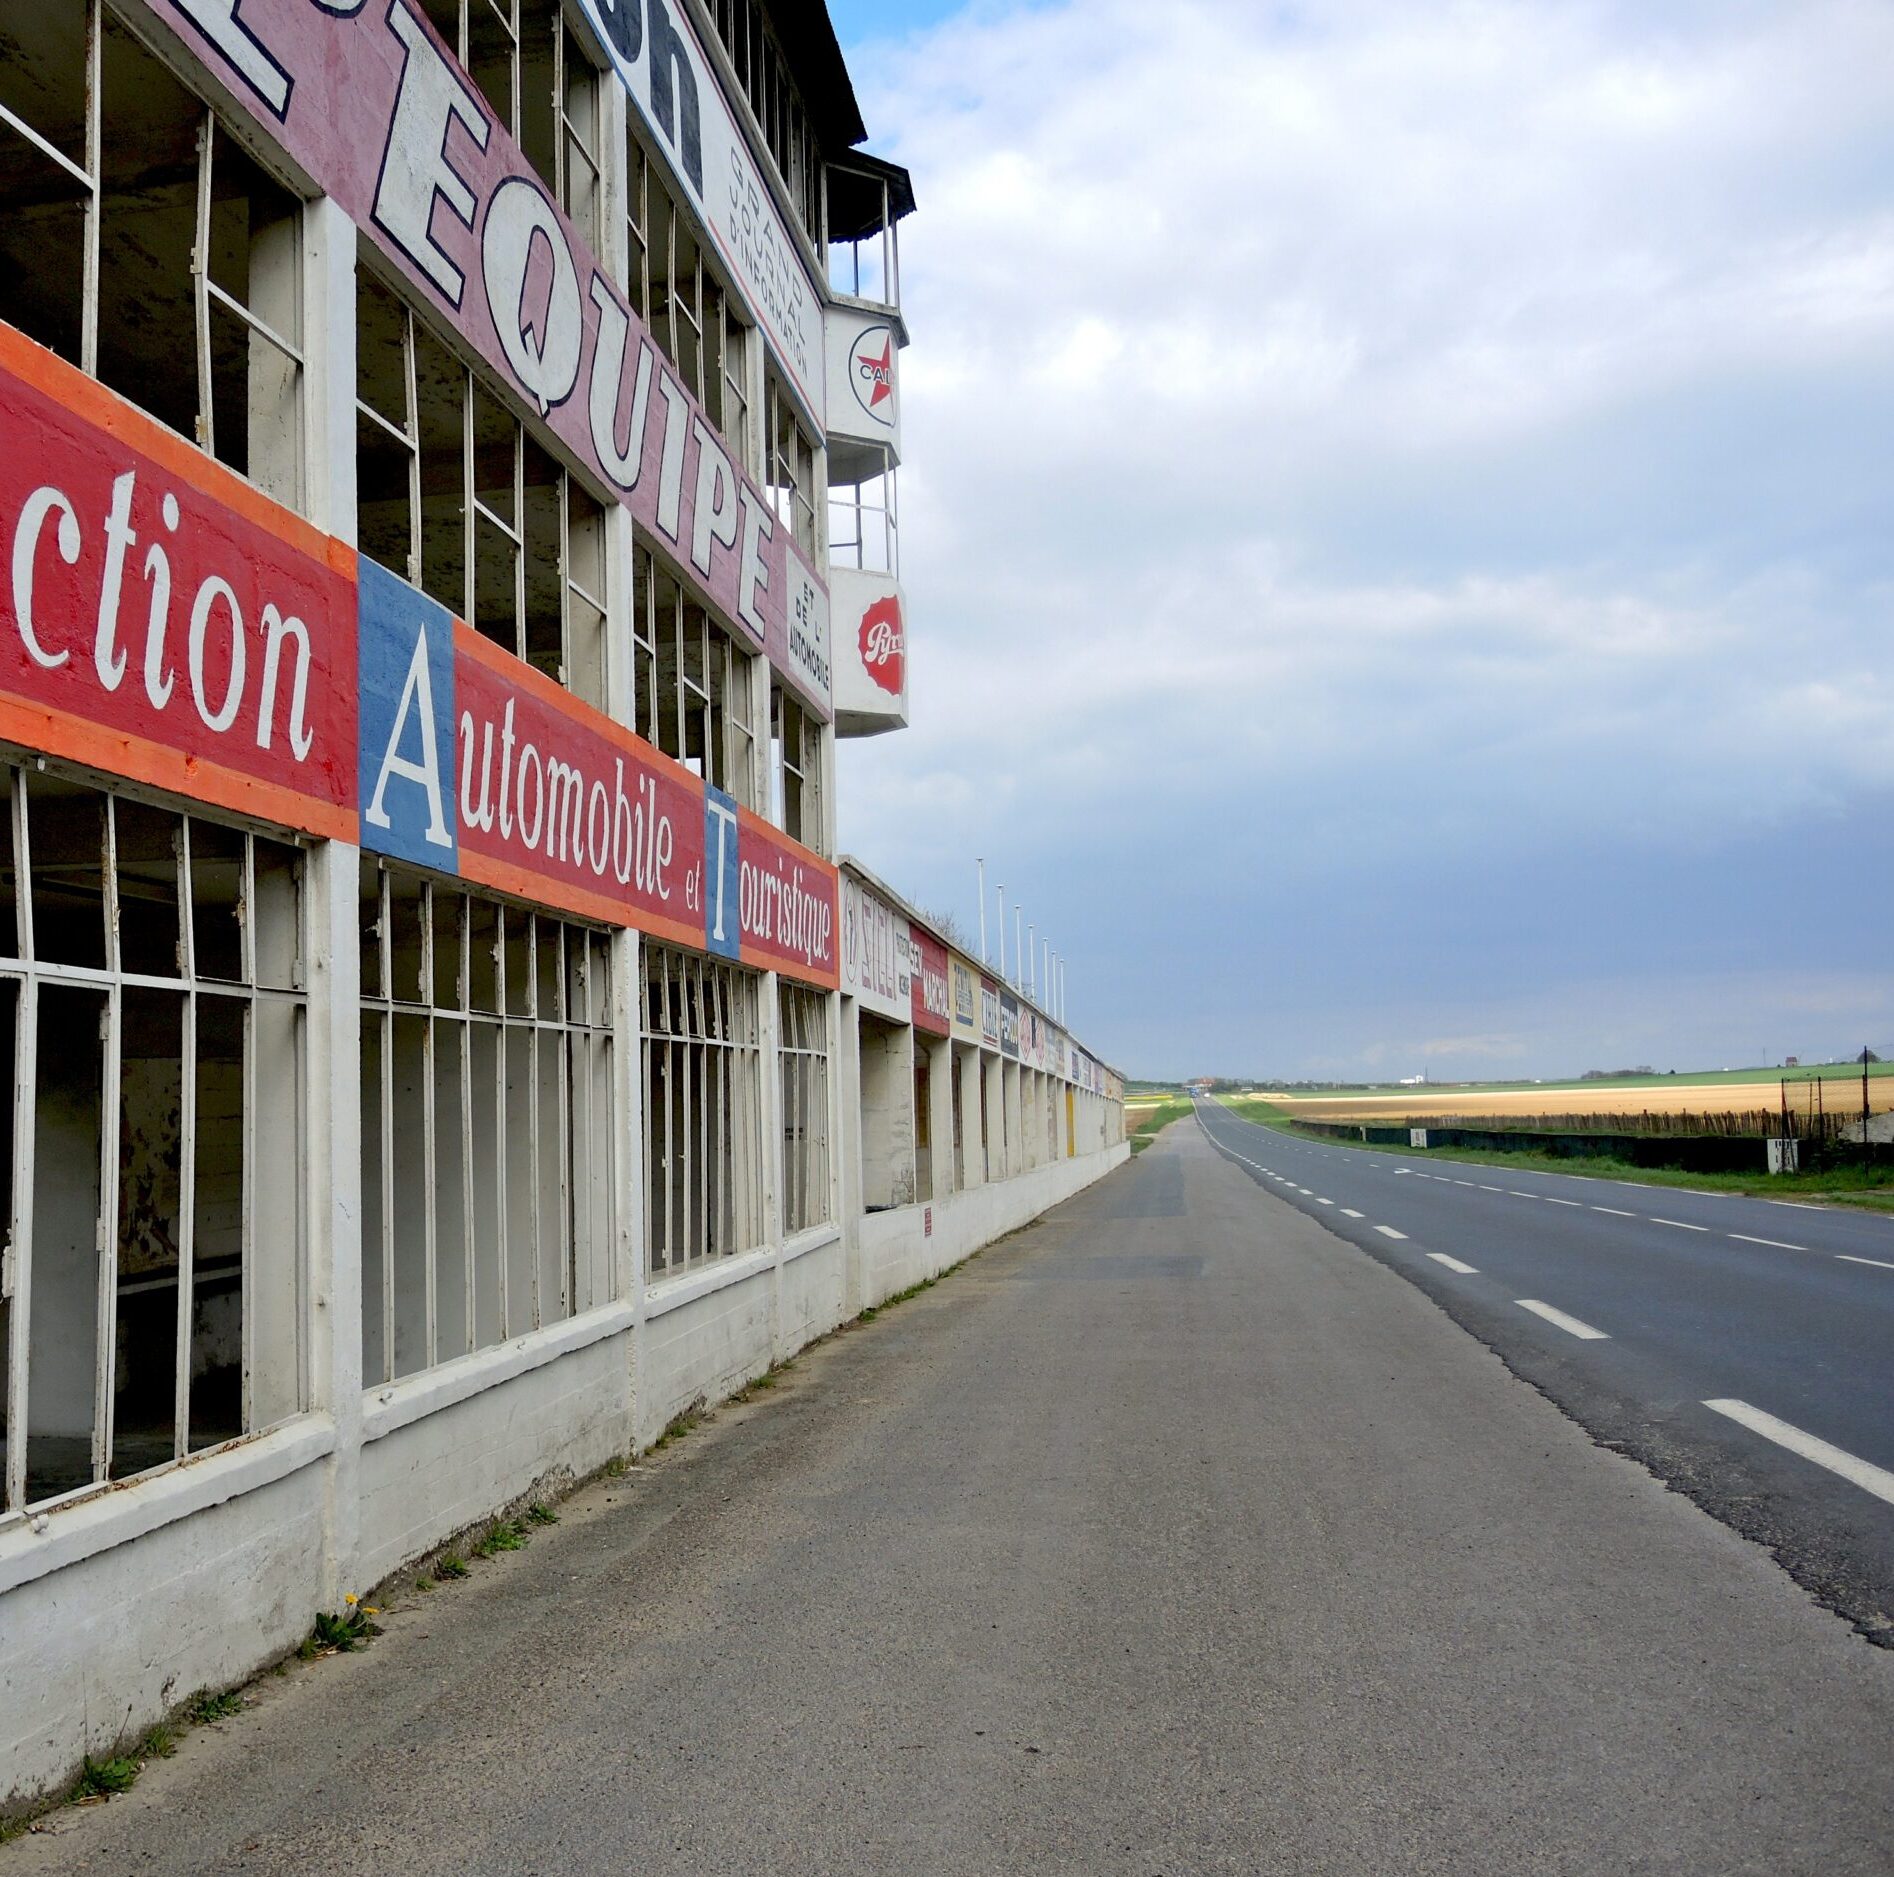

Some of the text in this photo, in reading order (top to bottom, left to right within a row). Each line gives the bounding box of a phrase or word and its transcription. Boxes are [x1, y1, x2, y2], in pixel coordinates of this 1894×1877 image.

[729, 184, 806, 346] JOURNAL
[729, 213, 808, 379] D'INFORMATION
[731, 146, 803, 308] GRAND
[789, 625, 830, 692] AUTOMOBILE
[796, 597, 808, 627] DE
[803, 581, 814, 610] ET
[365, 621, 673, 901] Automobile
[686, 859, 701, 912] et
[707, 798, 831, 967] Touristique
